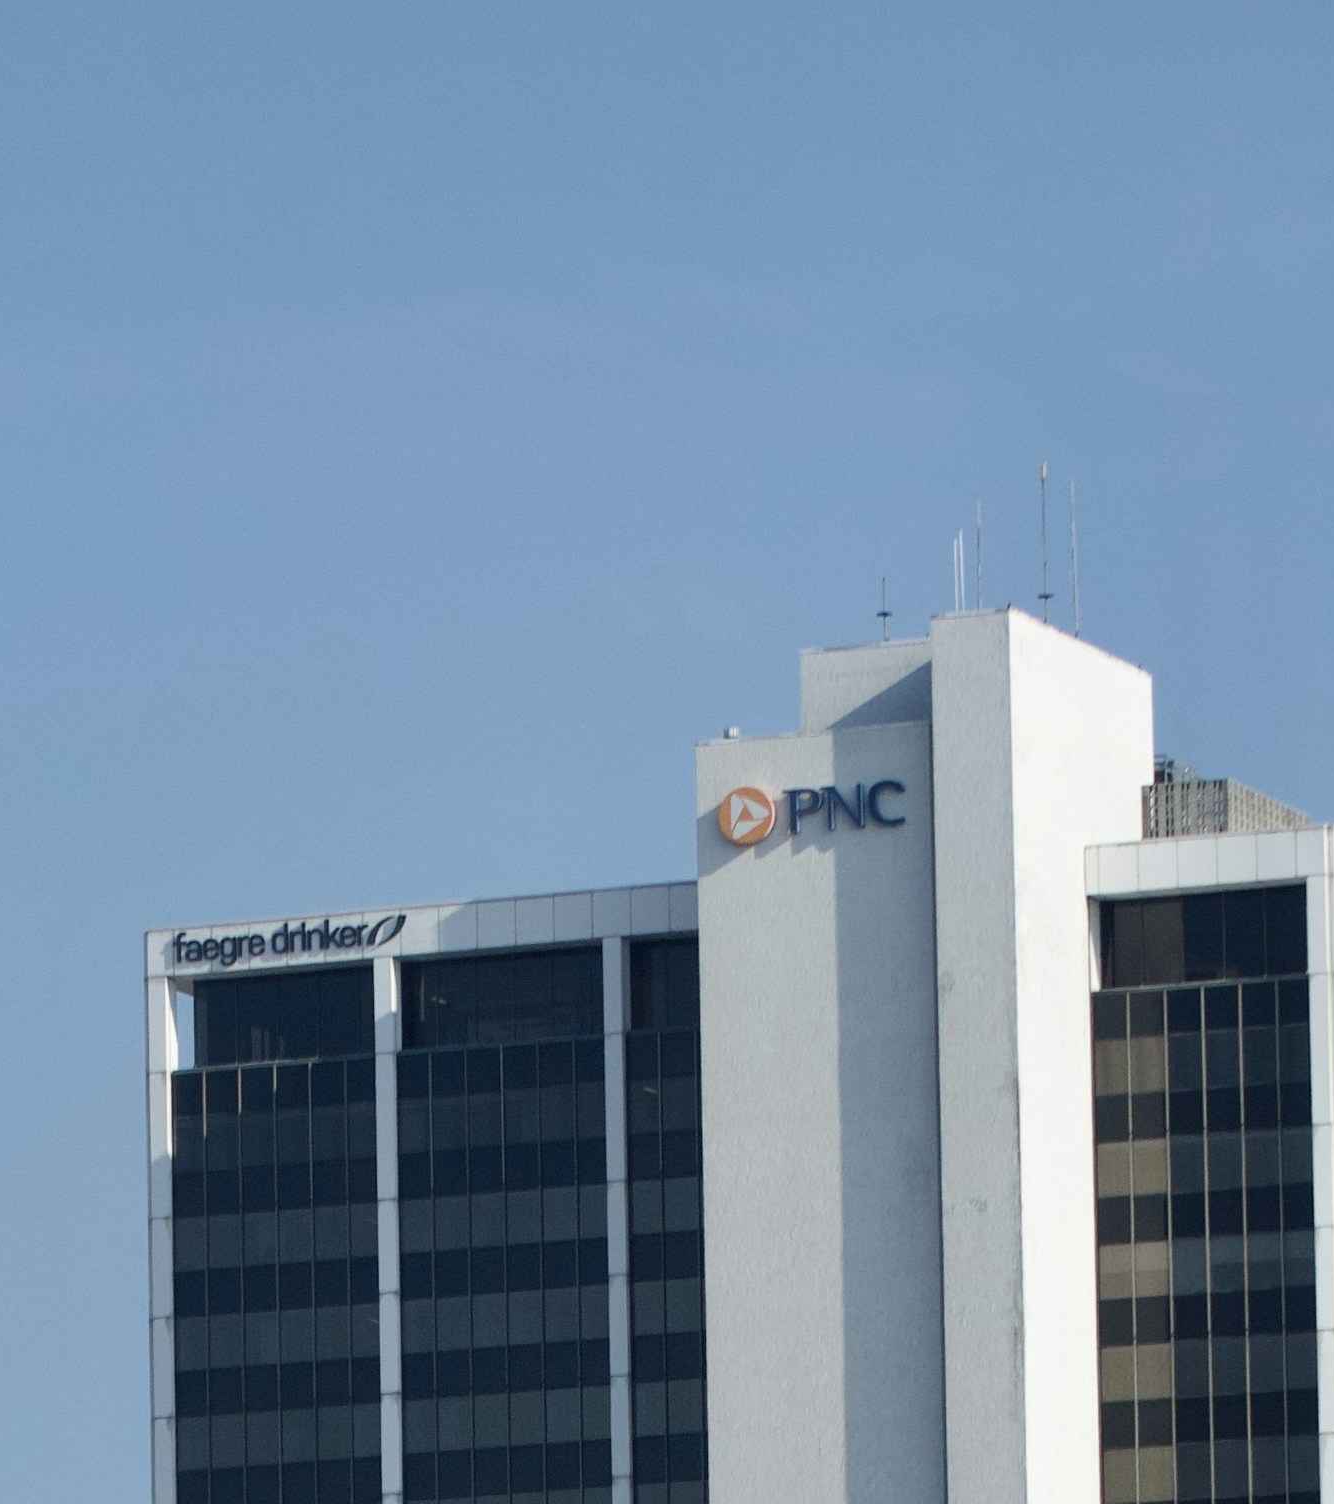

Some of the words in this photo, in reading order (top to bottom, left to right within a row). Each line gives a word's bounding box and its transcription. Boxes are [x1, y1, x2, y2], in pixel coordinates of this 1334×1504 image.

[782, 780, 906, 835] PNC
[173, 932, 266, 966] faegre
[271, 919, 369, 955] drinker
